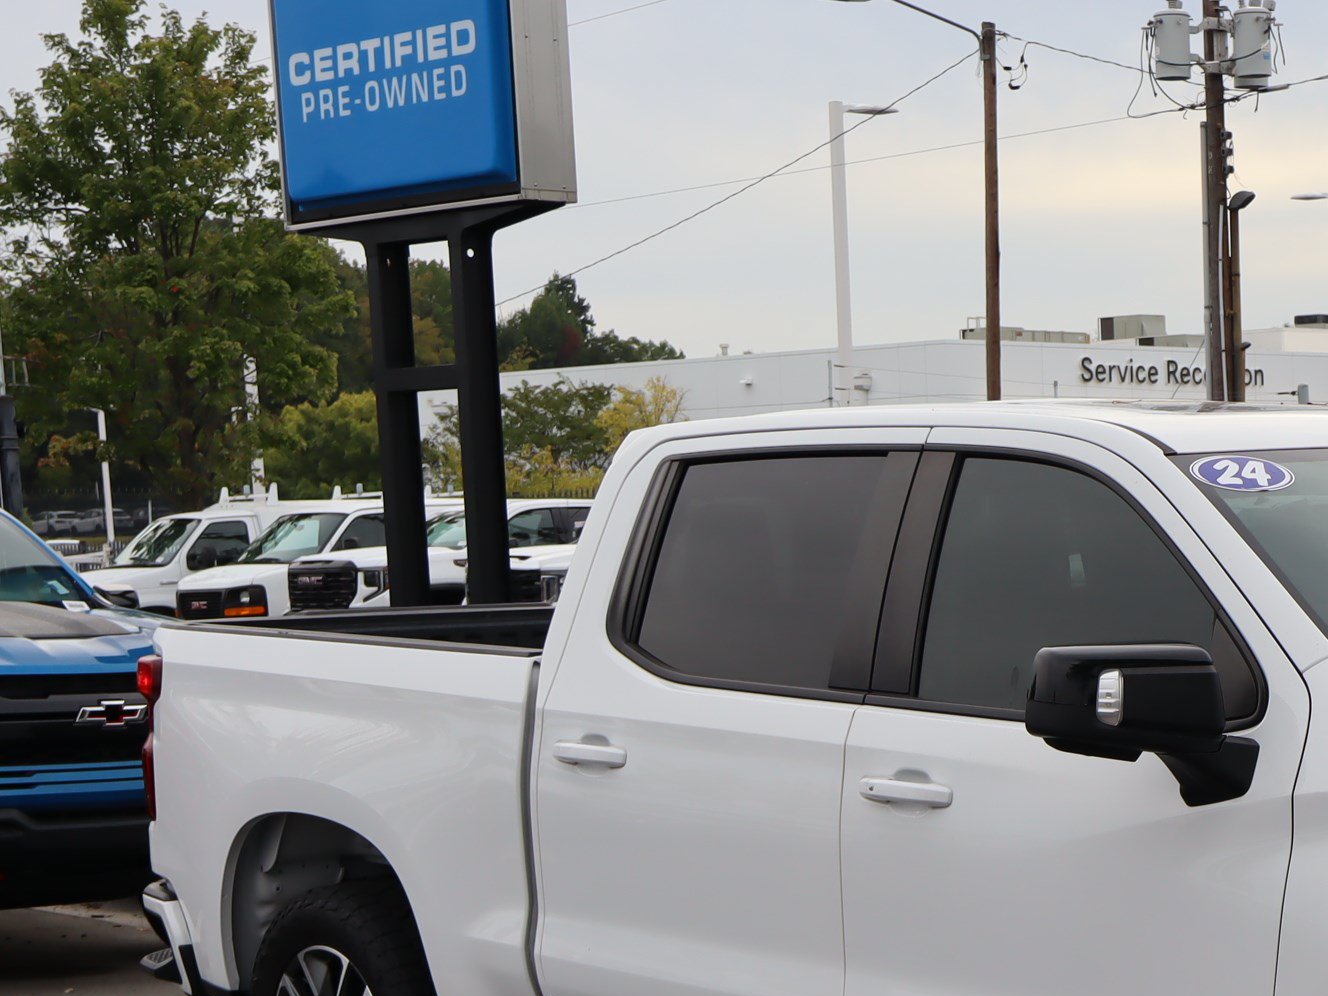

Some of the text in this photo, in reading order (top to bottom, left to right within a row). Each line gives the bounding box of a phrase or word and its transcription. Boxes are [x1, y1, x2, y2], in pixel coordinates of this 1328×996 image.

[288, 19, 476, 87] CERTIFIED
[301, 63, 468, 123] PRE-OWNED
[1080, 356, 1159, 384] Service
[1212, 459, 1272, 487] 24
